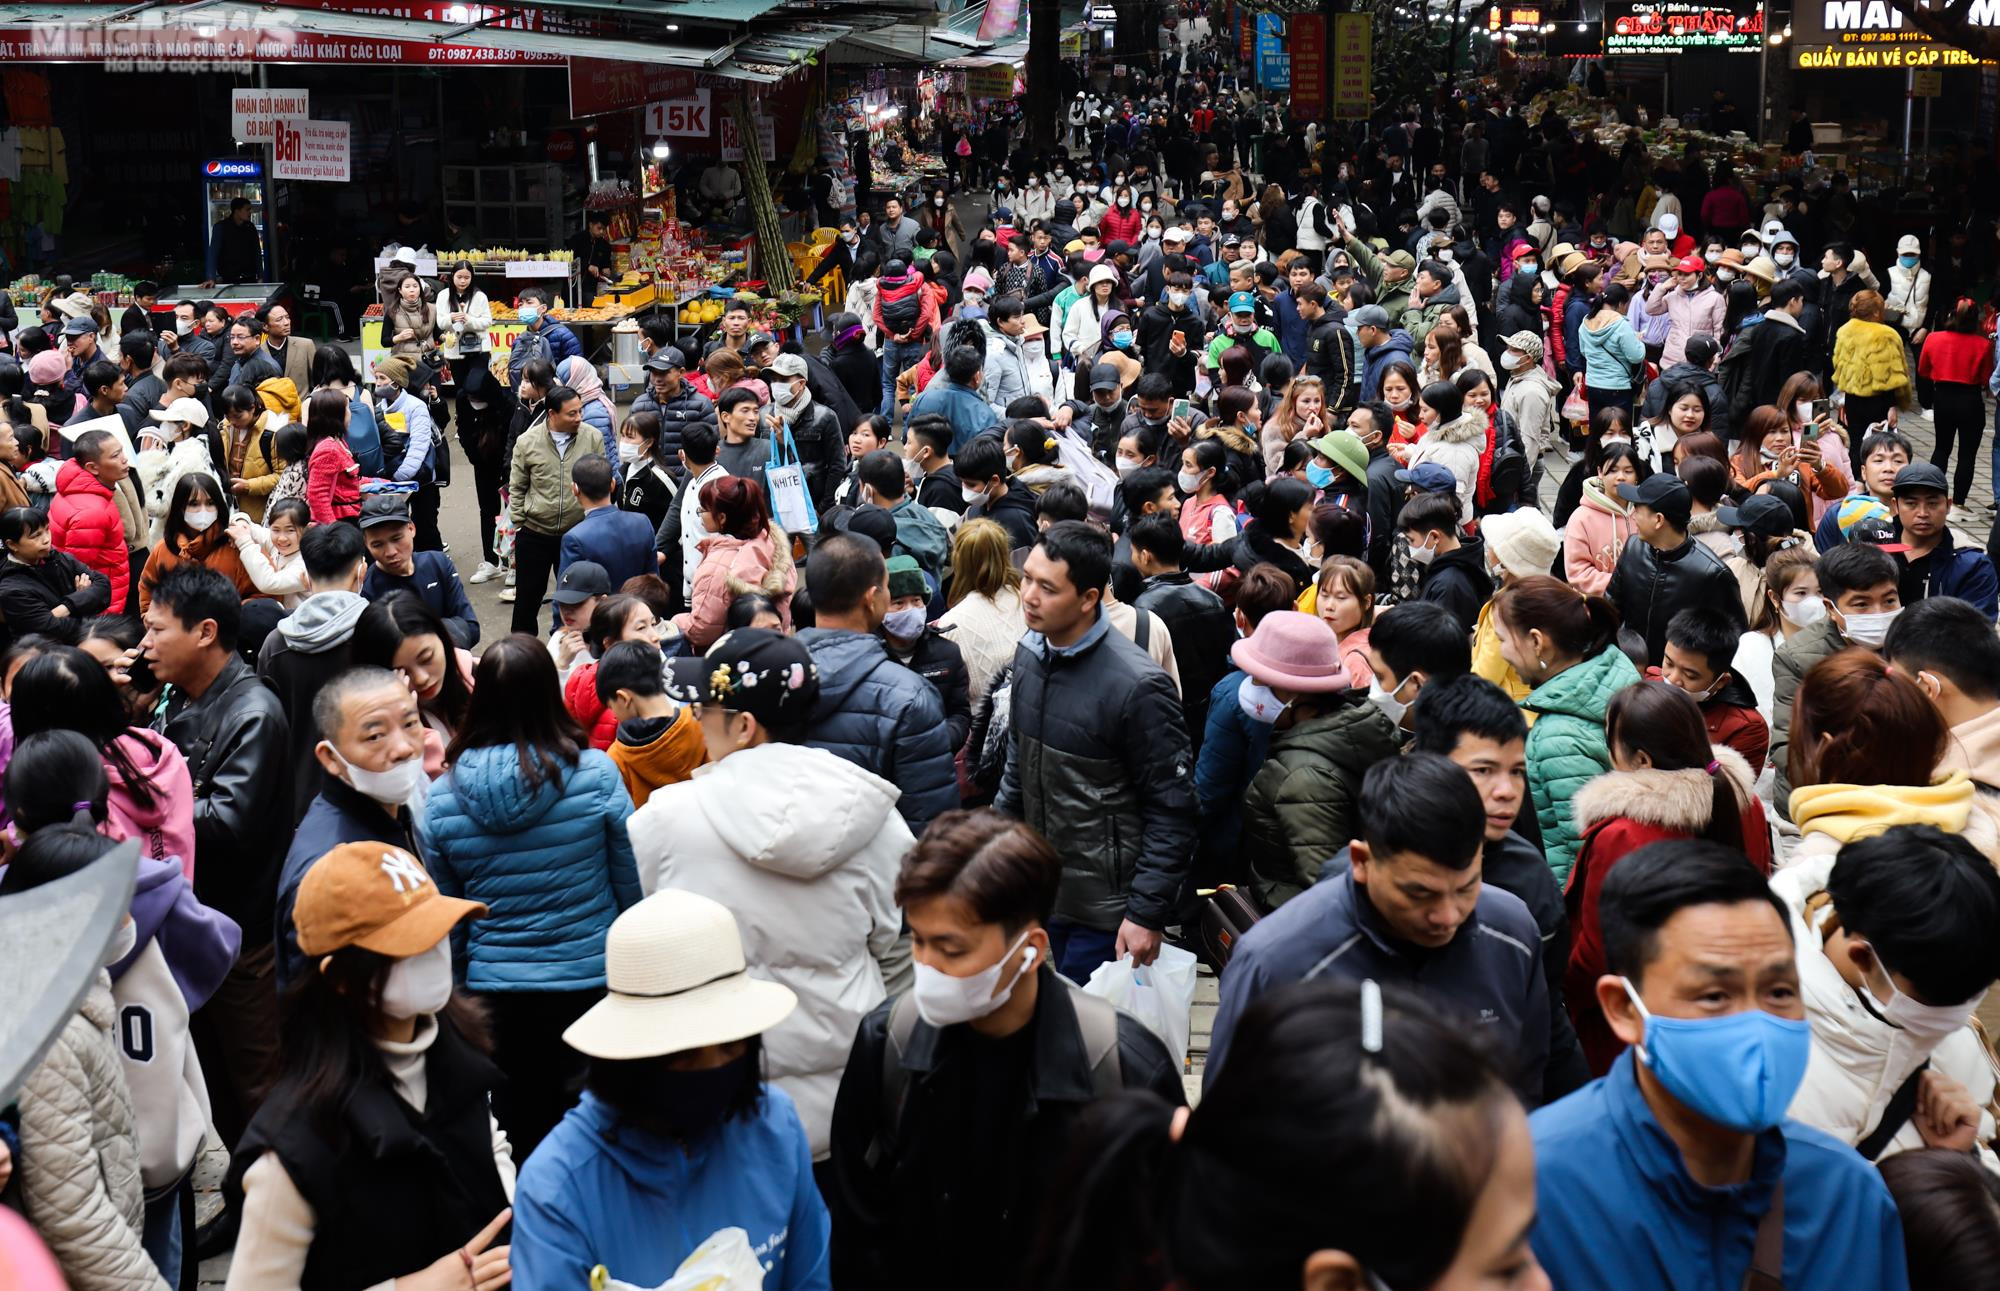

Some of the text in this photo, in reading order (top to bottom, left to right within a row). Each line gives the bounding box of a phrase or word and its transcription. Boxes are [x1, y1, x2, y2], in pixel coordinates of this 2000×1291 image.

[1861, 33, 1877, 42] 097
[1899, 33, 1918, 41] 1111
[228, 41, 244, 58] CÓ
[291, 39, 314, 58] GIẢI
[317, 42, 346, 58] KHÁT
[350, 42, 373, 59] CÁC
[376, 45, 402, 62] LOẠI
[428, 48, 445, 60] ĐT:
[447, 49, 516, 61] 0987.438.850
[1846, 47, 1878, 67] BÁN
[1905, 47, 1939, 65] CÁP
[235, 95, 256, 114] NHẬN
[274, 95, 295, 114] HÀNH
[297, 95, 307, 114] LÝ
[246, 117, 256, 136] CÓ
[653, 105, 706, 132] 15K
[275, 120, 301, 161] Bán
[223, 162, 254, 175] pepsi
[772, 475, 800, 489] WHITE
[630, 486, 644, 507] G
[381, 847, 427, 892] NY
